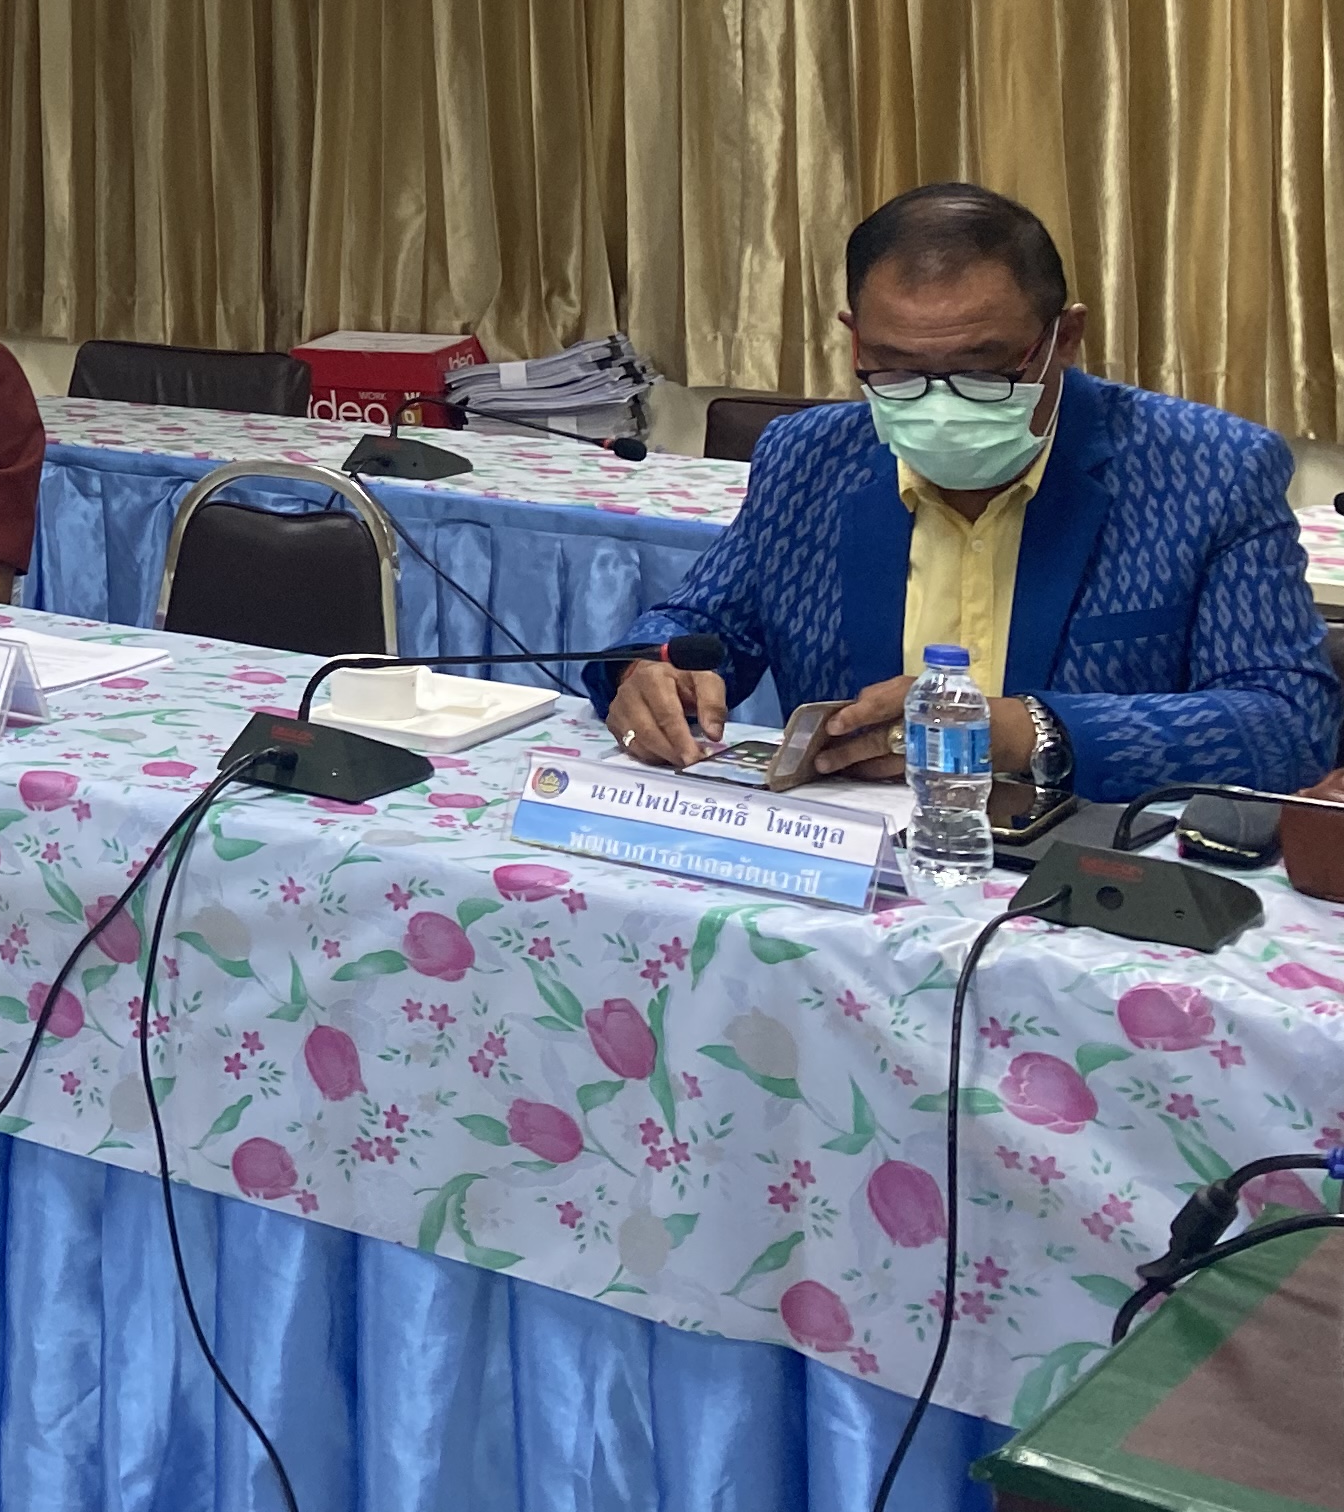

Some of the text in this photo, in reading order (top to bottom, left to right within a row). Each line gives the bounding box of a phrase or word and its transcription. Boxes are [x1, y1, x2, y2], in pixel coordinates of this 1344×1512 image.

[589, 782, 847, 850] นายไพประสิทธิ์ โพพิทูล
[569, 824, 823, 895] พัฒนาการอำเภอรัตนวาปี
